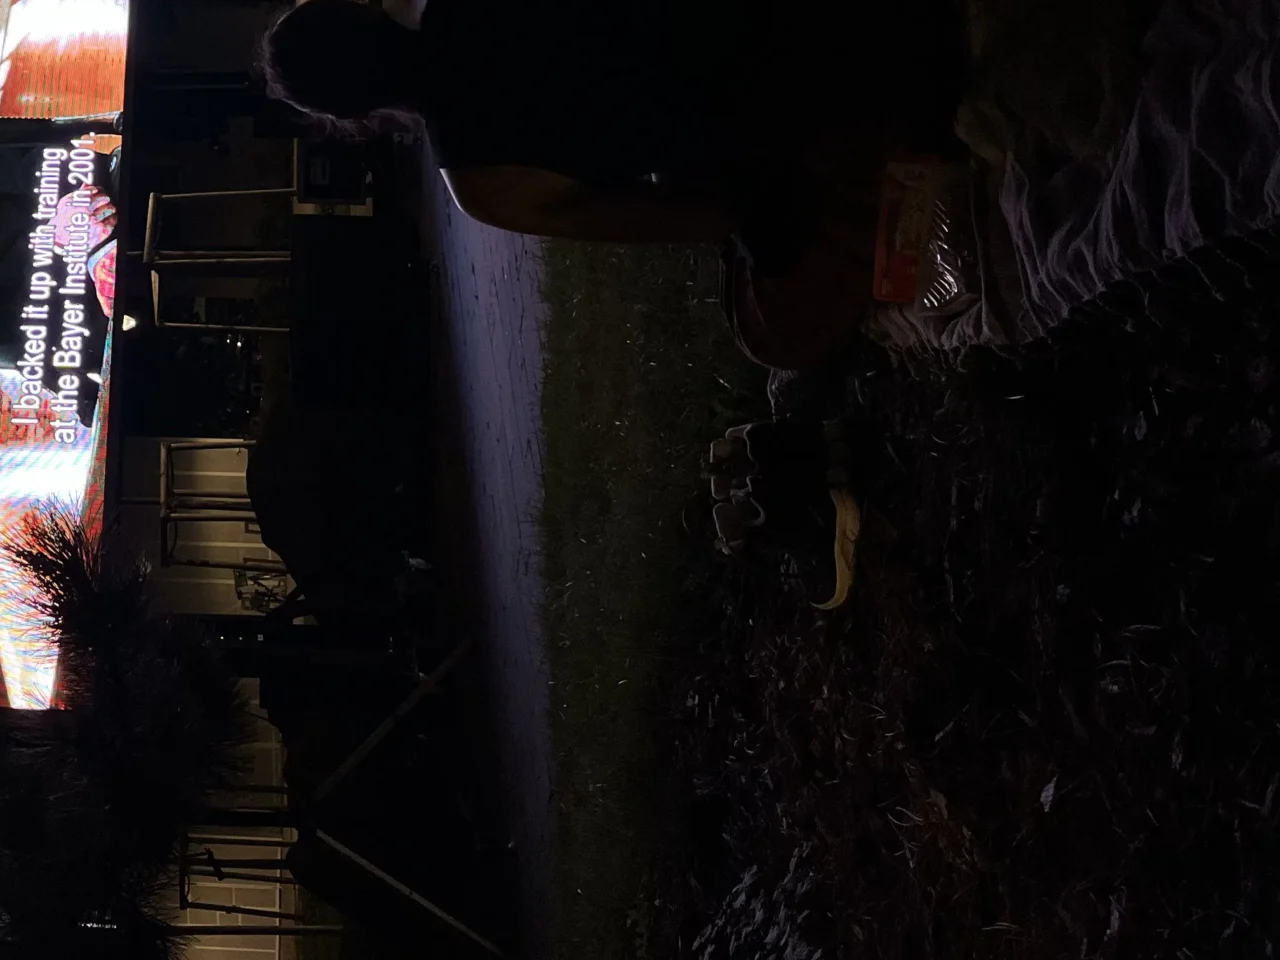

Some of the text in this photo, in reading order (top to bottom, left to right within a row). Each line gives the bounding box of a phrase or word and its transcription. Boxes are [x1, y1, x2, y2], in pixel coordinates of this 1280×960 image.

[32, 148, 68, 220] training
[28, 224, 56, 267] with
[20, 304, 49, 319] it
[29, 272, 58, 300] up
[50, 132, 96, 444] at the Bayer Institute in 2001.
[12, 324, 48, 410] backed
